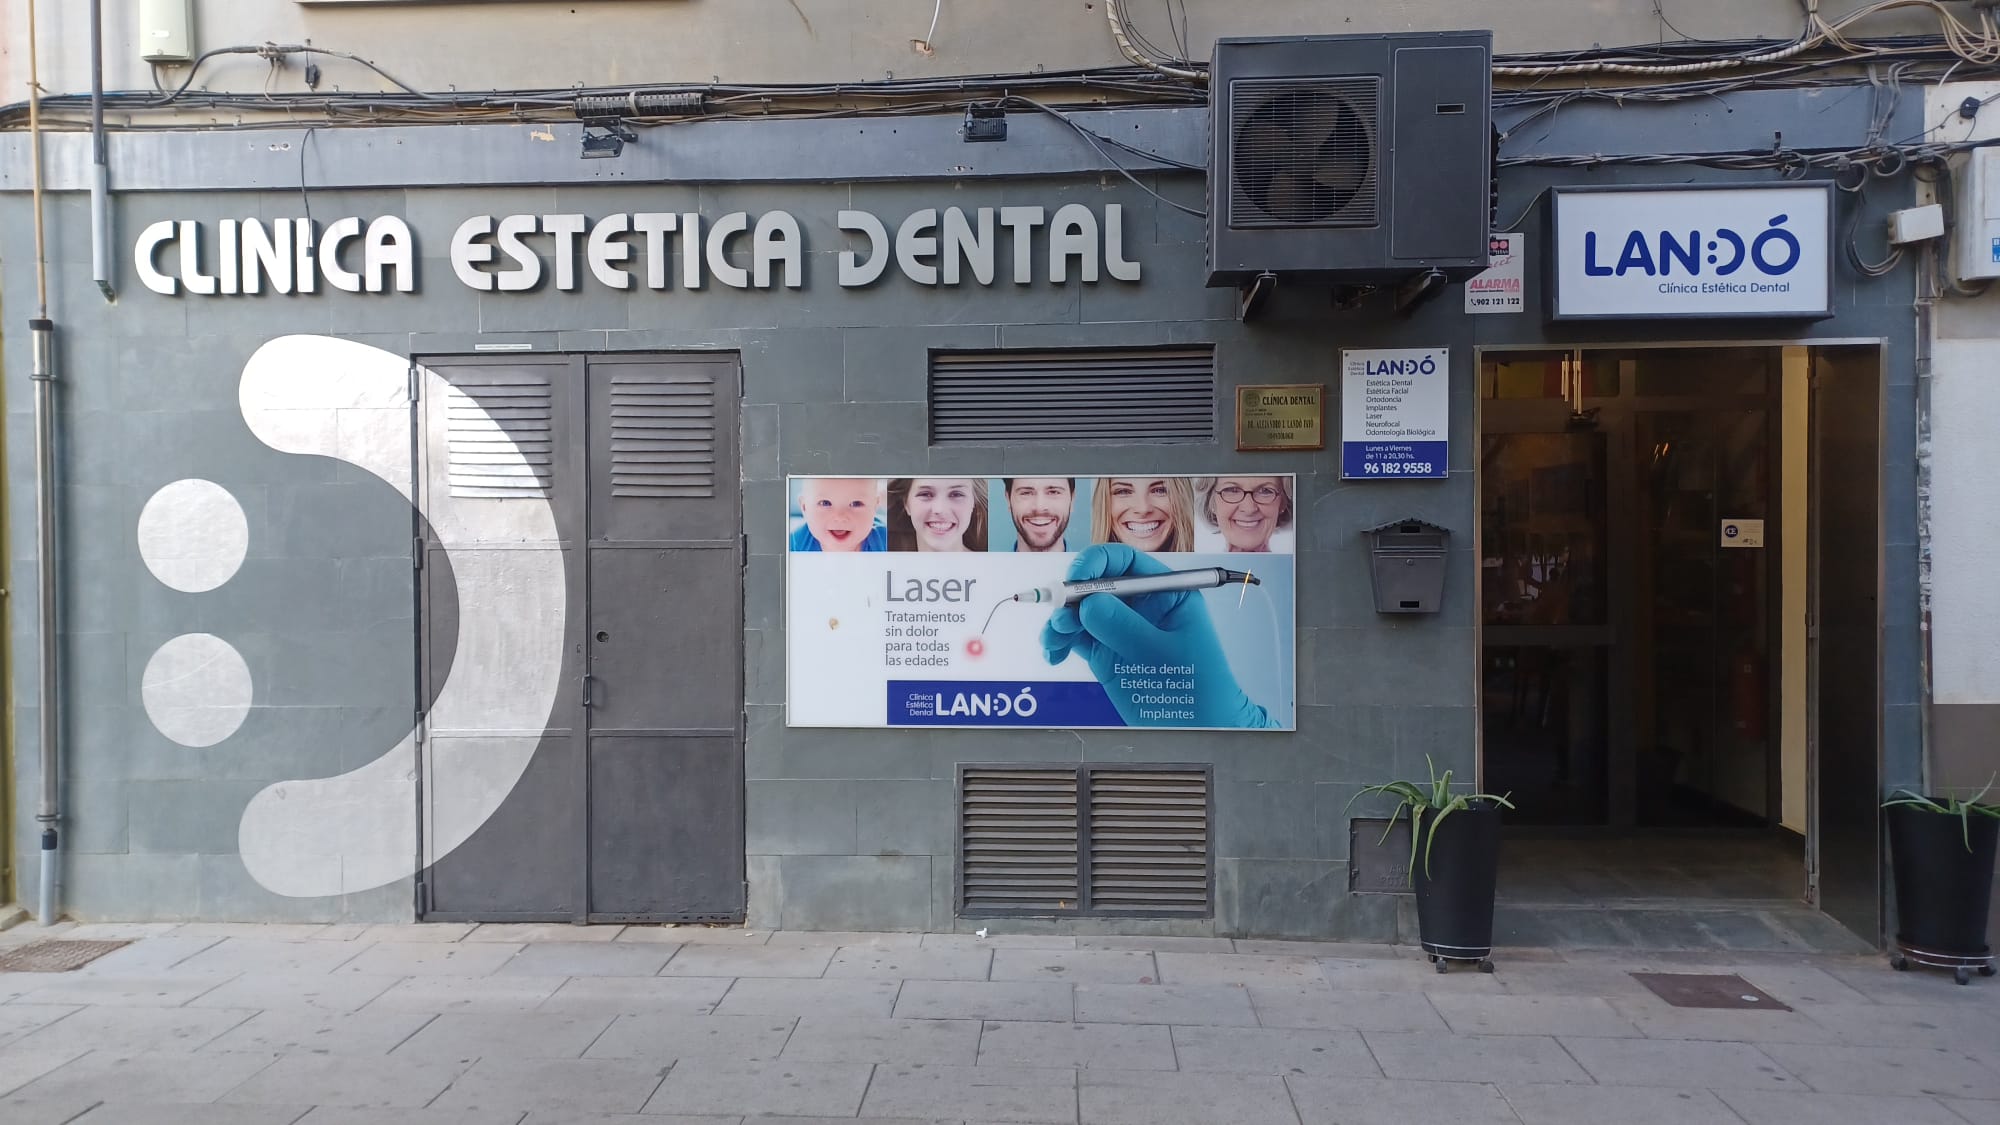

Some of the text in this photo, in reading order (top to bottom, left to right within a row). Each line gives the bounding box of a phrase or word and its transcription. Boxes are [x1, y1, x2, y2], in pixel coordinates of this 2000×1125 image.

[450, 210, 801, 291] ESTETICA
[838, 203, 1141, 286] DENTAL
[1470, 278, 1520, 289] ALARMA
[1658, 281, 1790, 294] Clínica Estética Dental
[1476, 298, 1490, 306] 902
[1366, 379, 1413, 387] Estética Dental
[1366, 387, 1409, 395] Estética Facial
[1290, 396, 1315, 406] DENTAL
[1366, 404, 1398, 412] Implantes
[1366, 428, 1436, 437] Odontología Biológica
[1364, 463, 1432, 474] 96 182 9558
[886, 570, 976, 602] Laser
[884, 610, 966, 623] Tratamientos
[885, 625, 939, 637] sin dolor
[885, 640, 950, 655] para todas
[885, 654, 949, 666] las edades
[1114, 663, 1195, 675] Estética dental
[1120, 678, 1195, 689] Estética facial
[908, 692, 934, 701] Clínica
[1131, 693, 1195, 704] Ortodoncia
[905, 700, 934, 709] Estética
[909, 709, 934, 717] Dental
[1140, 707, 1195, 721] Implantes
